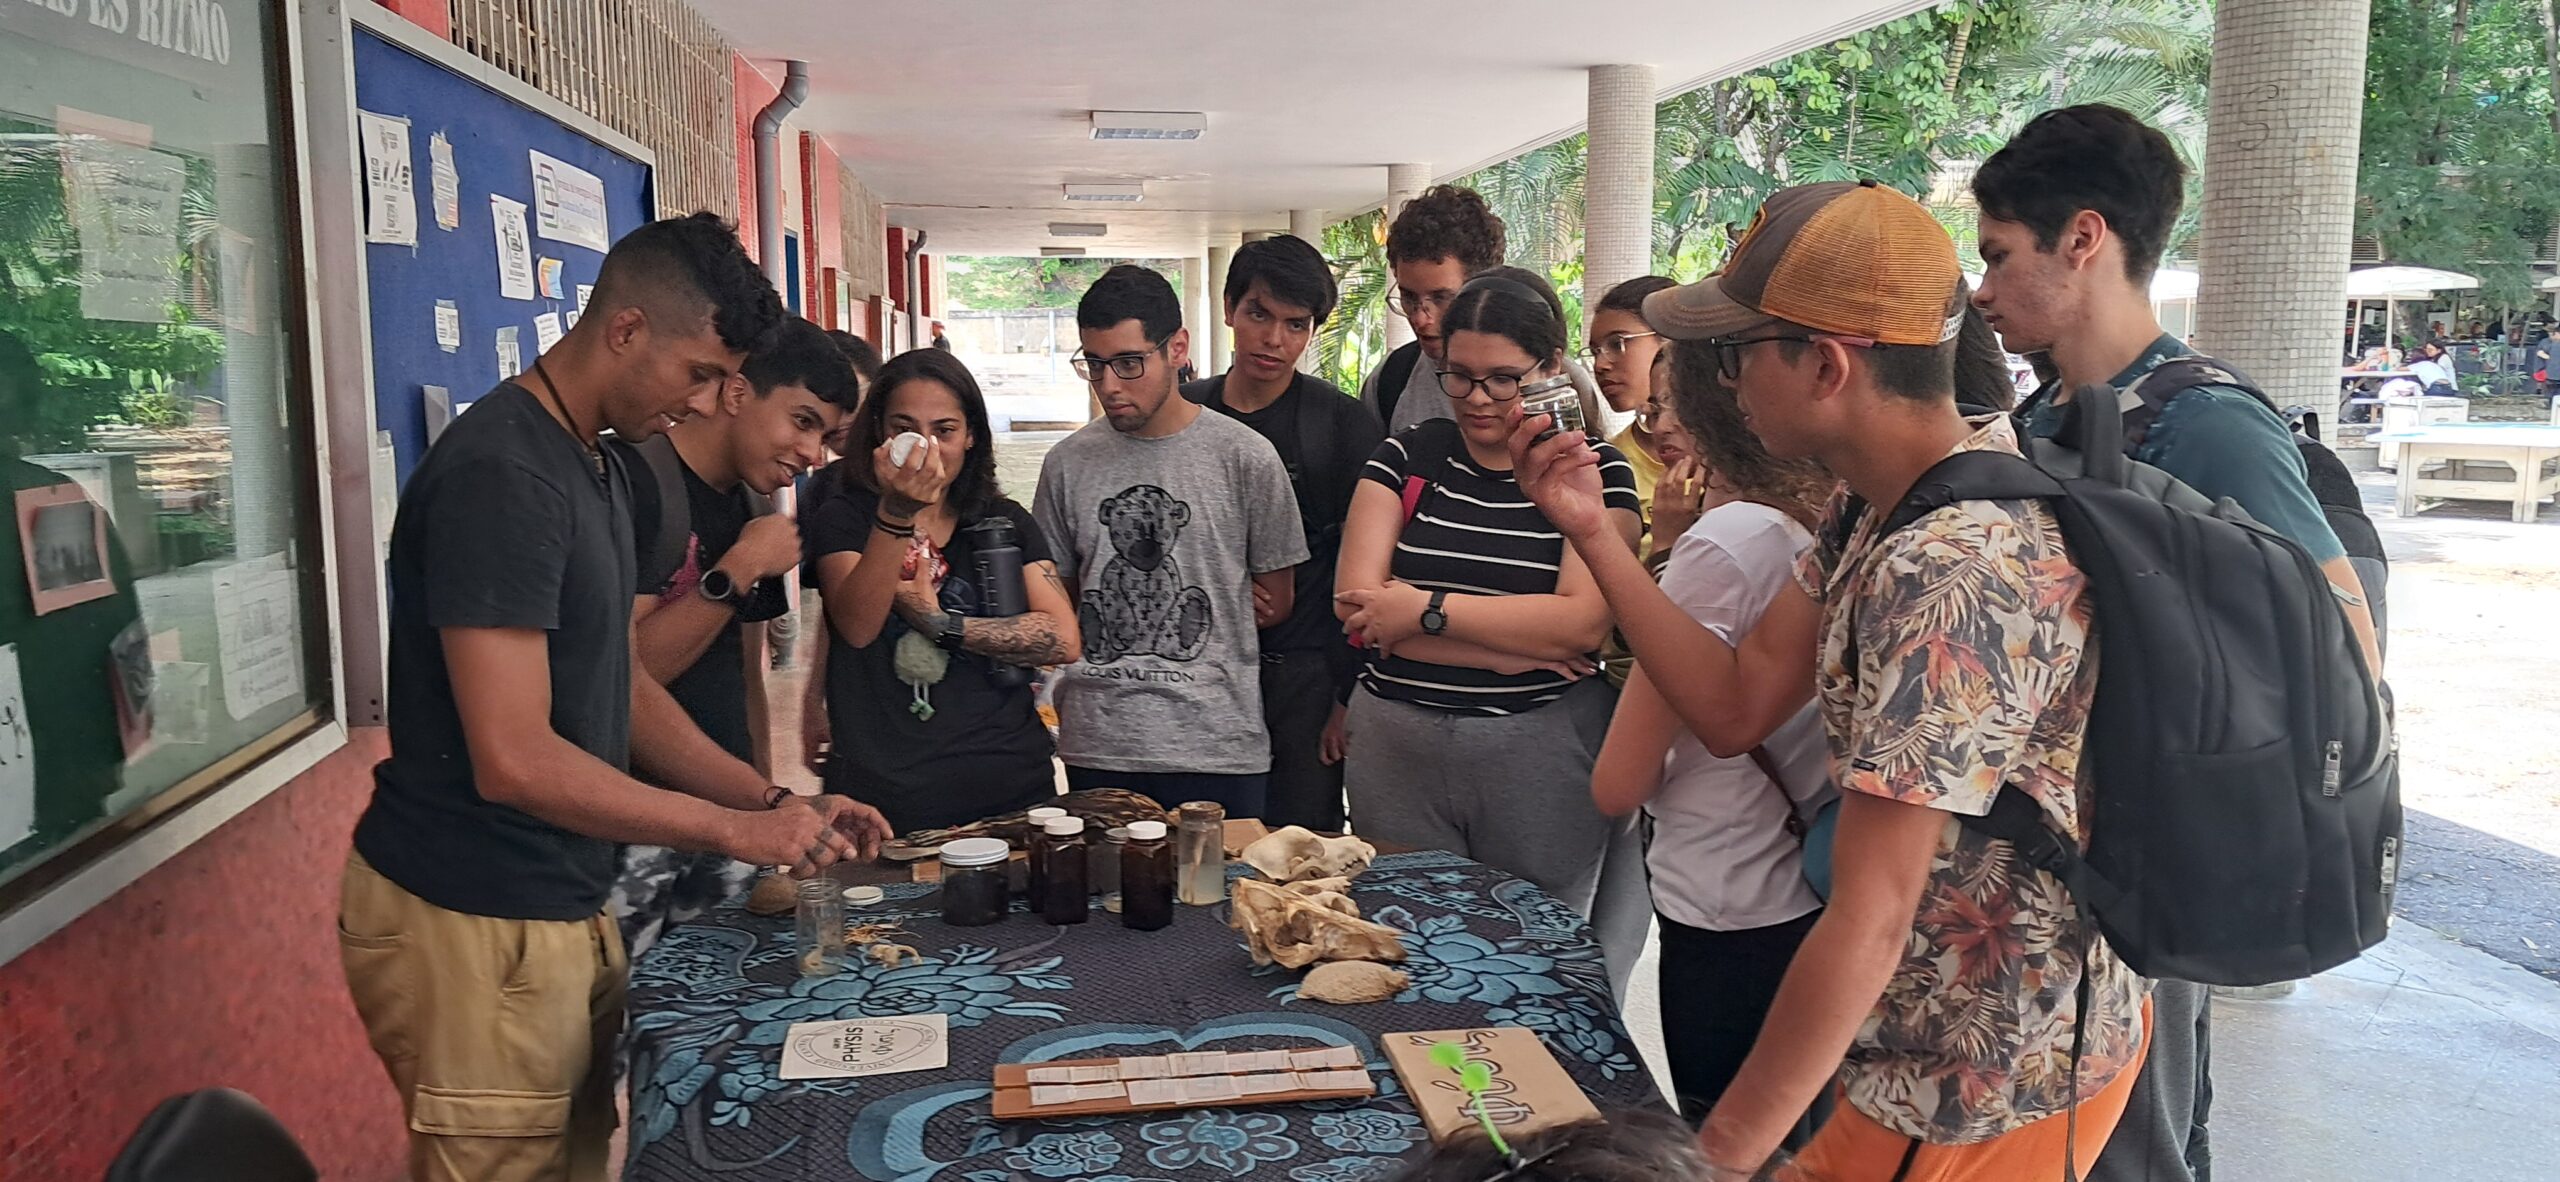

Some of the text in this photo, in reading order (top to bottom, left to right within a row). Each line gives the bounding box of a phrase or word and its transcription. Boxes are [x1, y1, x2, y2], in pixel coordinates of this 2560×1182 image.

[137, 0, 230, 65] RITMO
[1081, 666, 1196, 683] LOUIS VUITTON
[843, 1026, 864, 1063] PHYSIS
